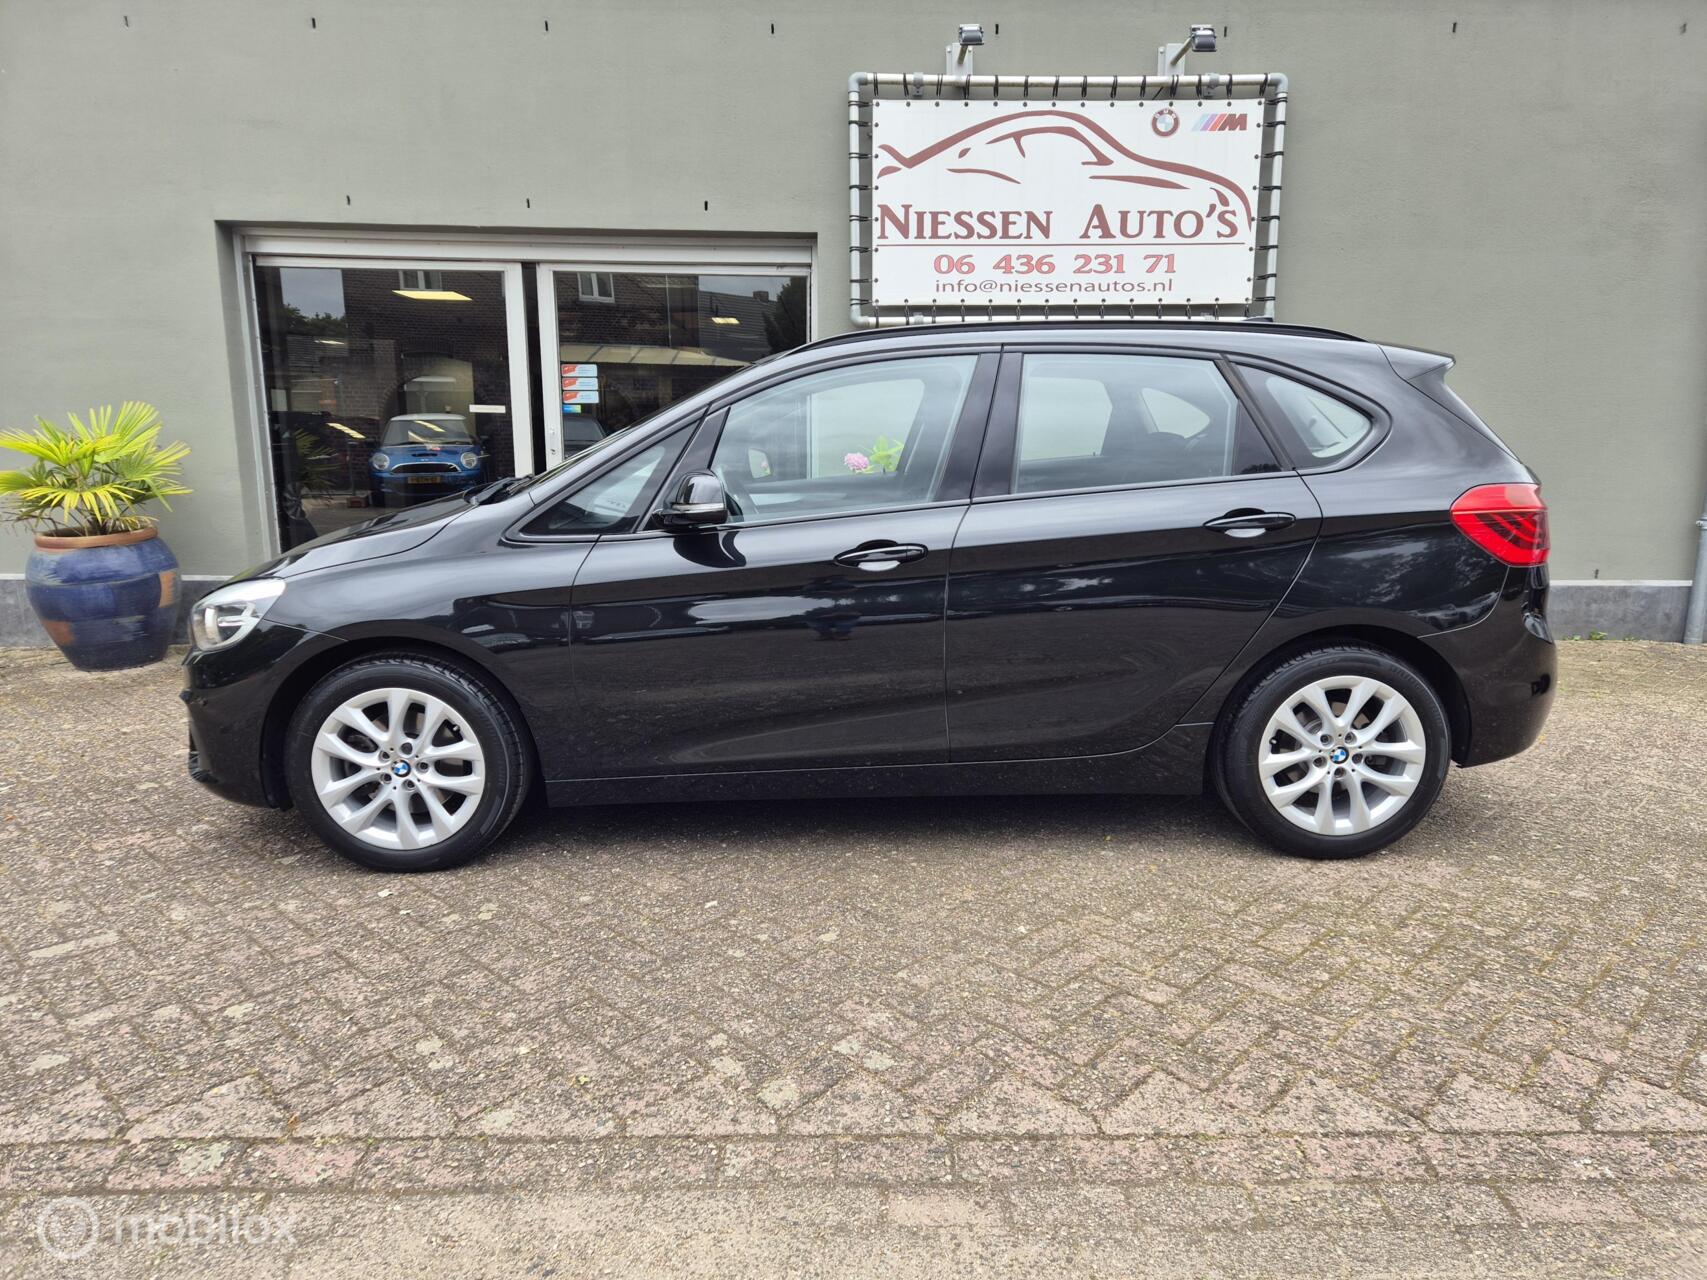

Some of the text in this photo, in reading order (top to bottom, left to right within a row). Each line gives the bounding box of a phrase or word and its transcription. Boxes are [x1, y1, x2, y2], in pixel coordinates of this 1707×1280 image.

[877, 203, 1239, 240] NIESSEN AUTO'S
[933, 253, 1177, 275] 06 436 231 71
[935, 278, 1173, 293] info@niessenautos.nl
